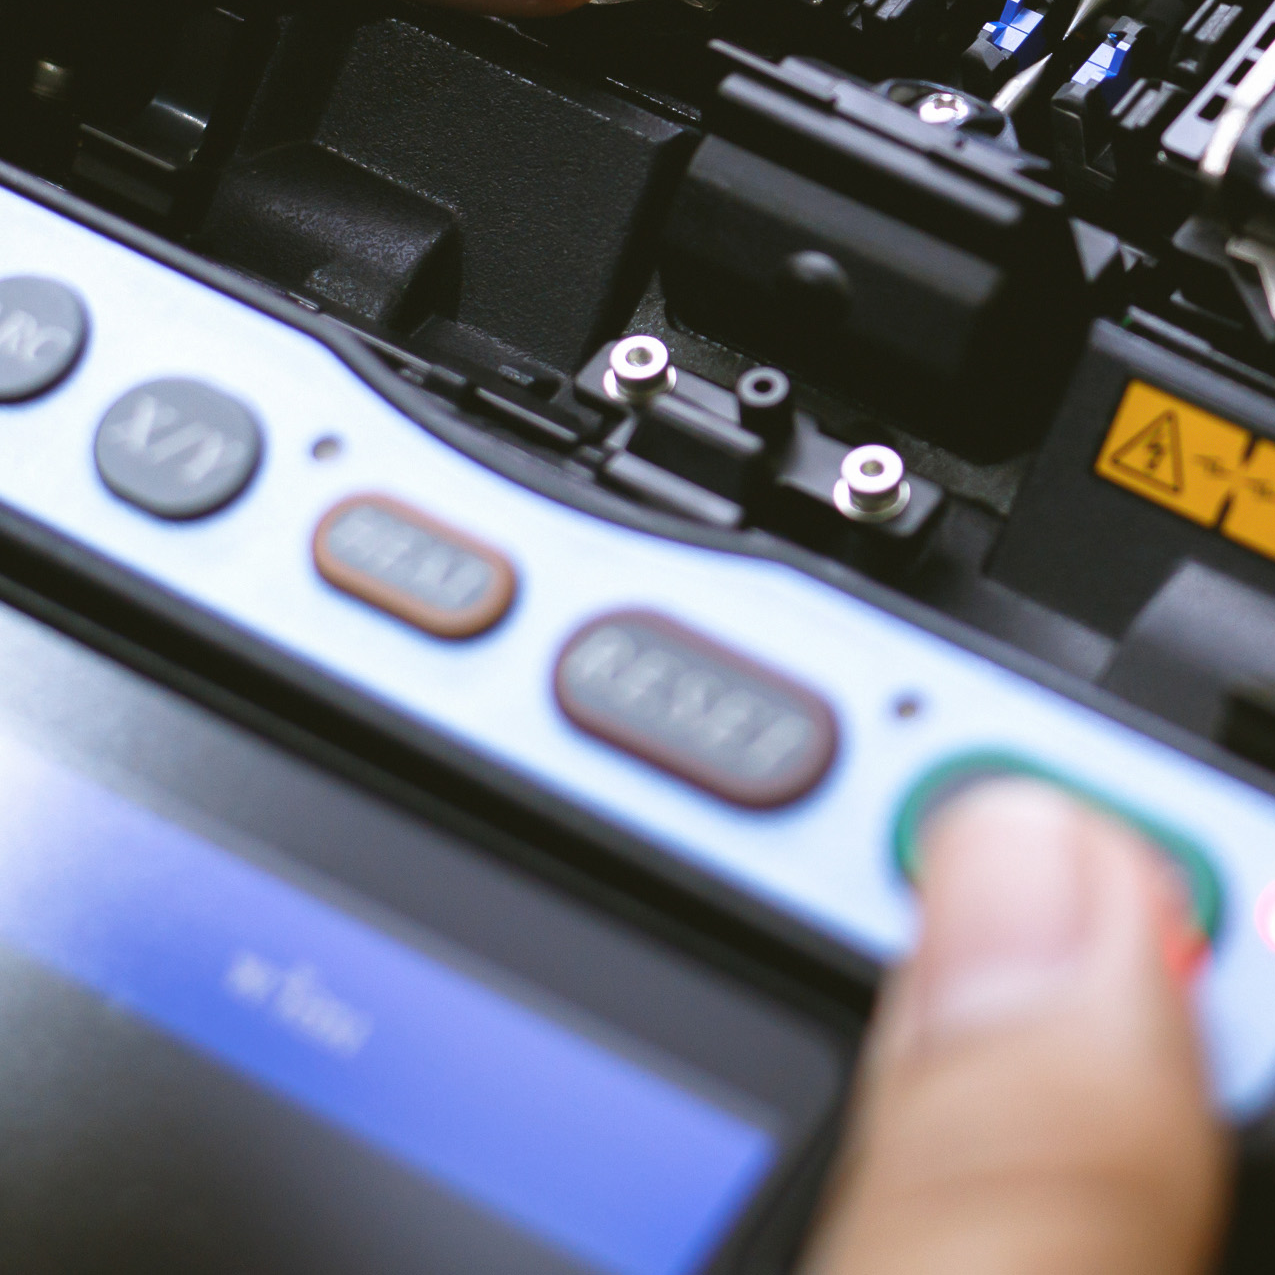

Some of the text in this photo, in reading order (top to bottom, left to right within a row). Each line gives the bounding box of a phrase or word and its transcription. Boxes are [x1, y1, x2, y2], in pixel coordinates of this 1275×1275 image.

[0, 302, 72, 361] RC
[110, 393, 243, 482] X/Y
[568, 628, 812, 774] RESET
